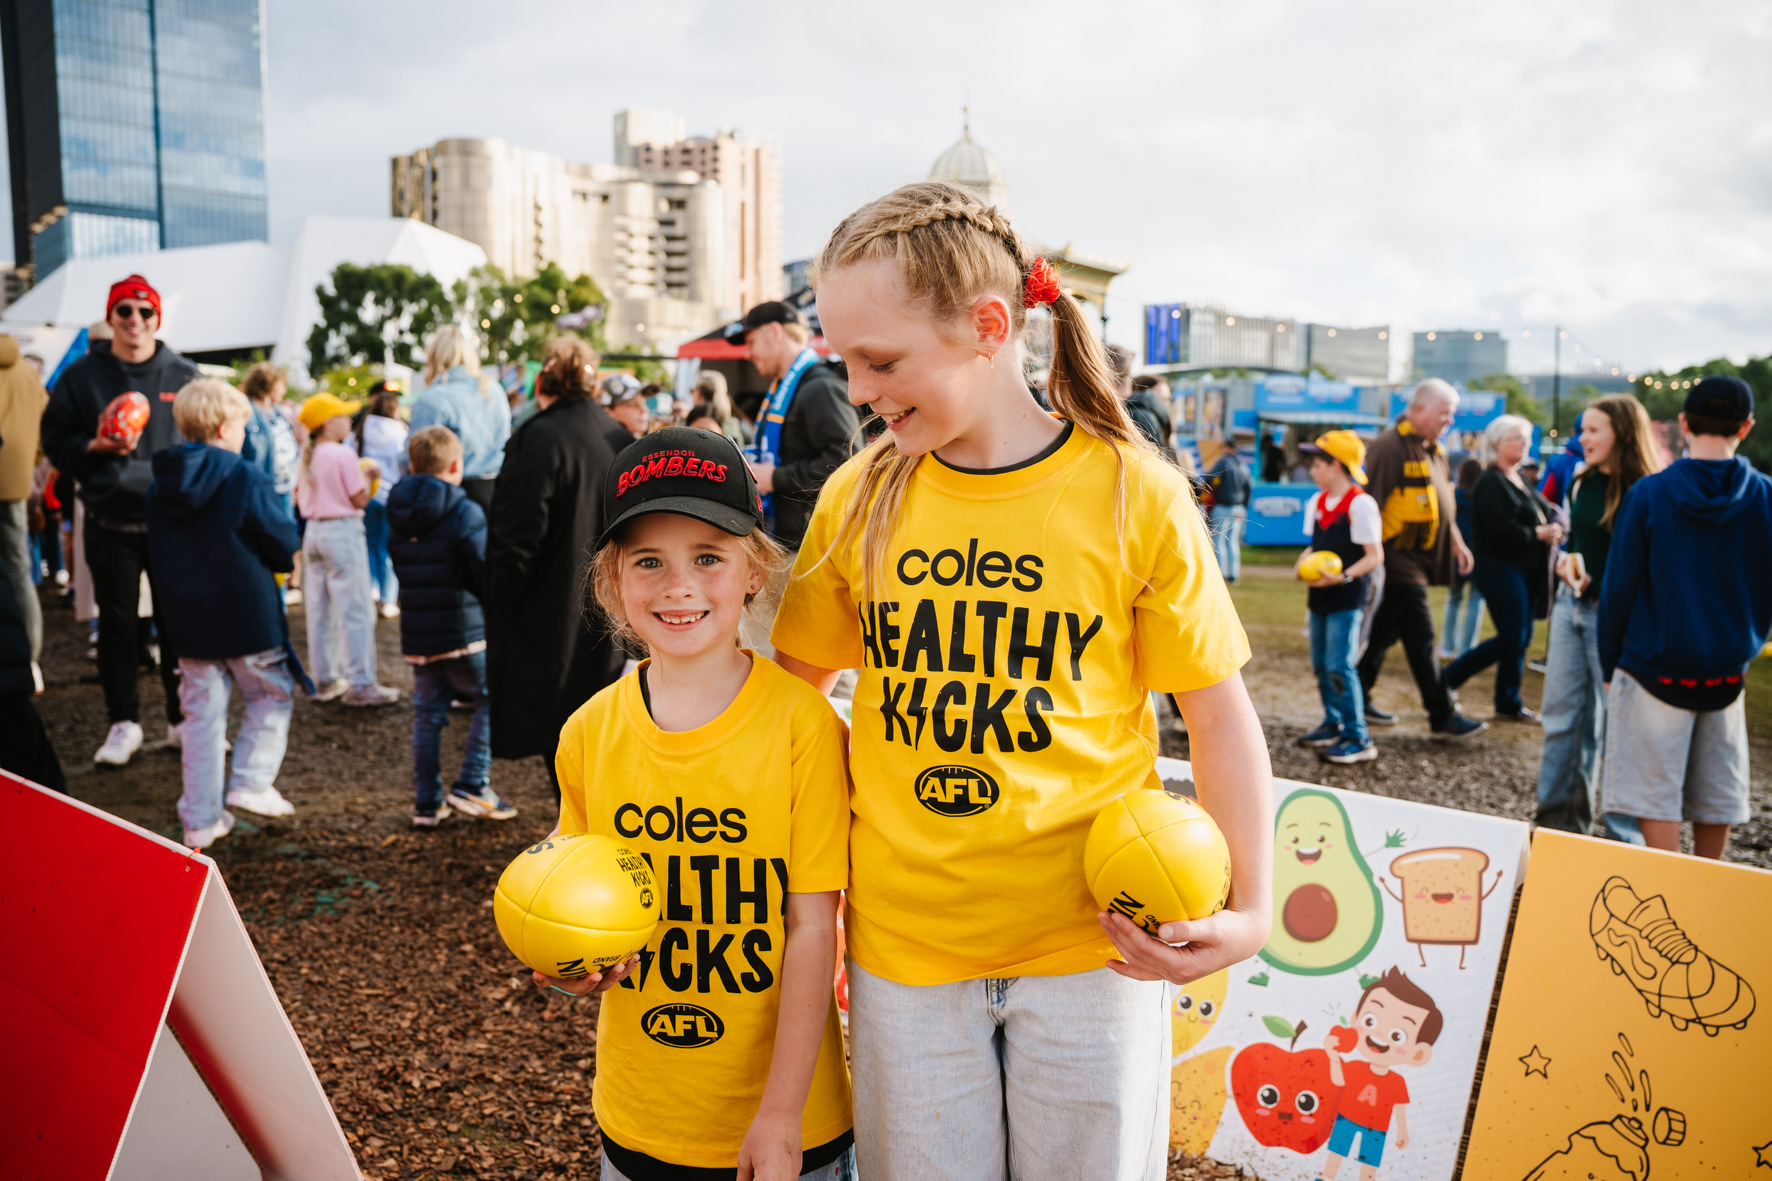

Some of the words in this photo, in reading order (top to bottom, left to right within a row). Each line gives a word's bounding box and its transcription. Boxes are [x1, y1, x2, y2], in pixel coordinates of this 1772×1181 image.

[642, 450, 695, 463] ESSENDON
[616, 457, 728, 497] BOMBERS
[896, 538, 1044, 592] coles
[858, 598, 1103, 681] HEALTHY
[880, 676, 1054, 754] KICKS
[919, 777, 992, 804] AFL
[614, 797, 748, 843] coles
[648, 1013, 718, 1038] AFL
[1357, 1083, 1377, 1107] A
